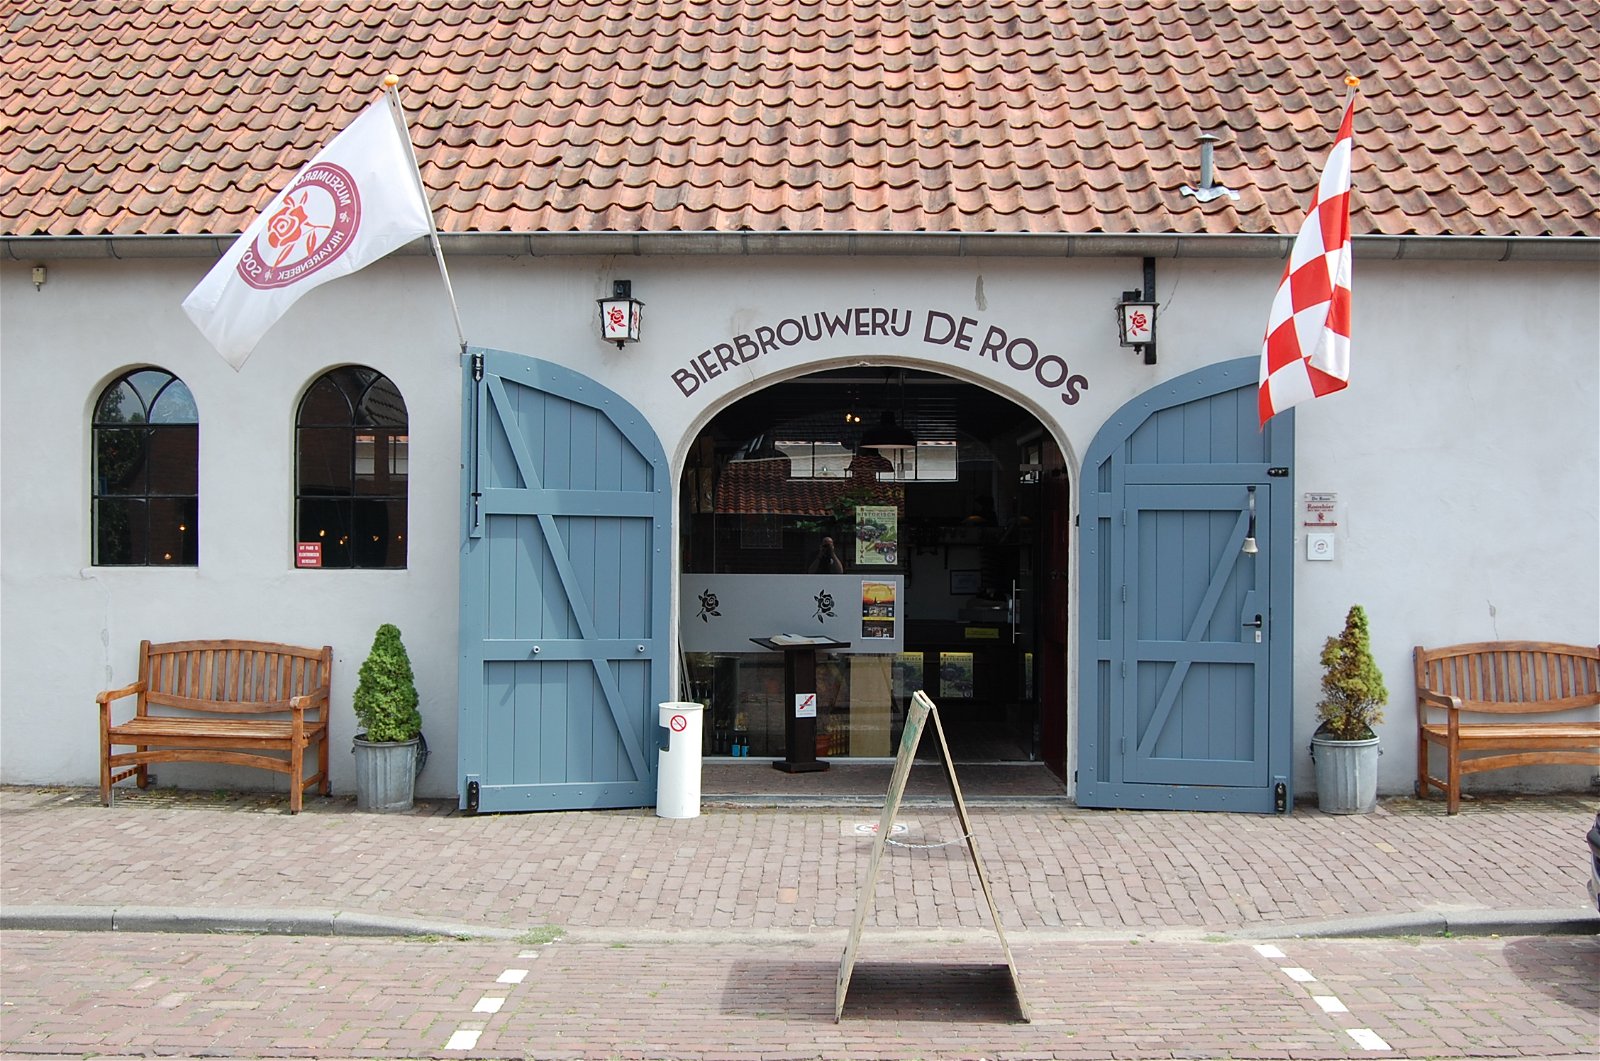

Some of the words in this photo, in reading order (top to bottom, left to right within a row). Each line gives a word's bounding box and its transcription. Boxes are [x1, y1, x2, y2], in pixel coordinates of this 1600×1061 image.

[671, 308, 912, 398] BIERBROUWERIJ
[924, 310, 978, 351] DE
[979, 325, 1088, 405] ROOS
